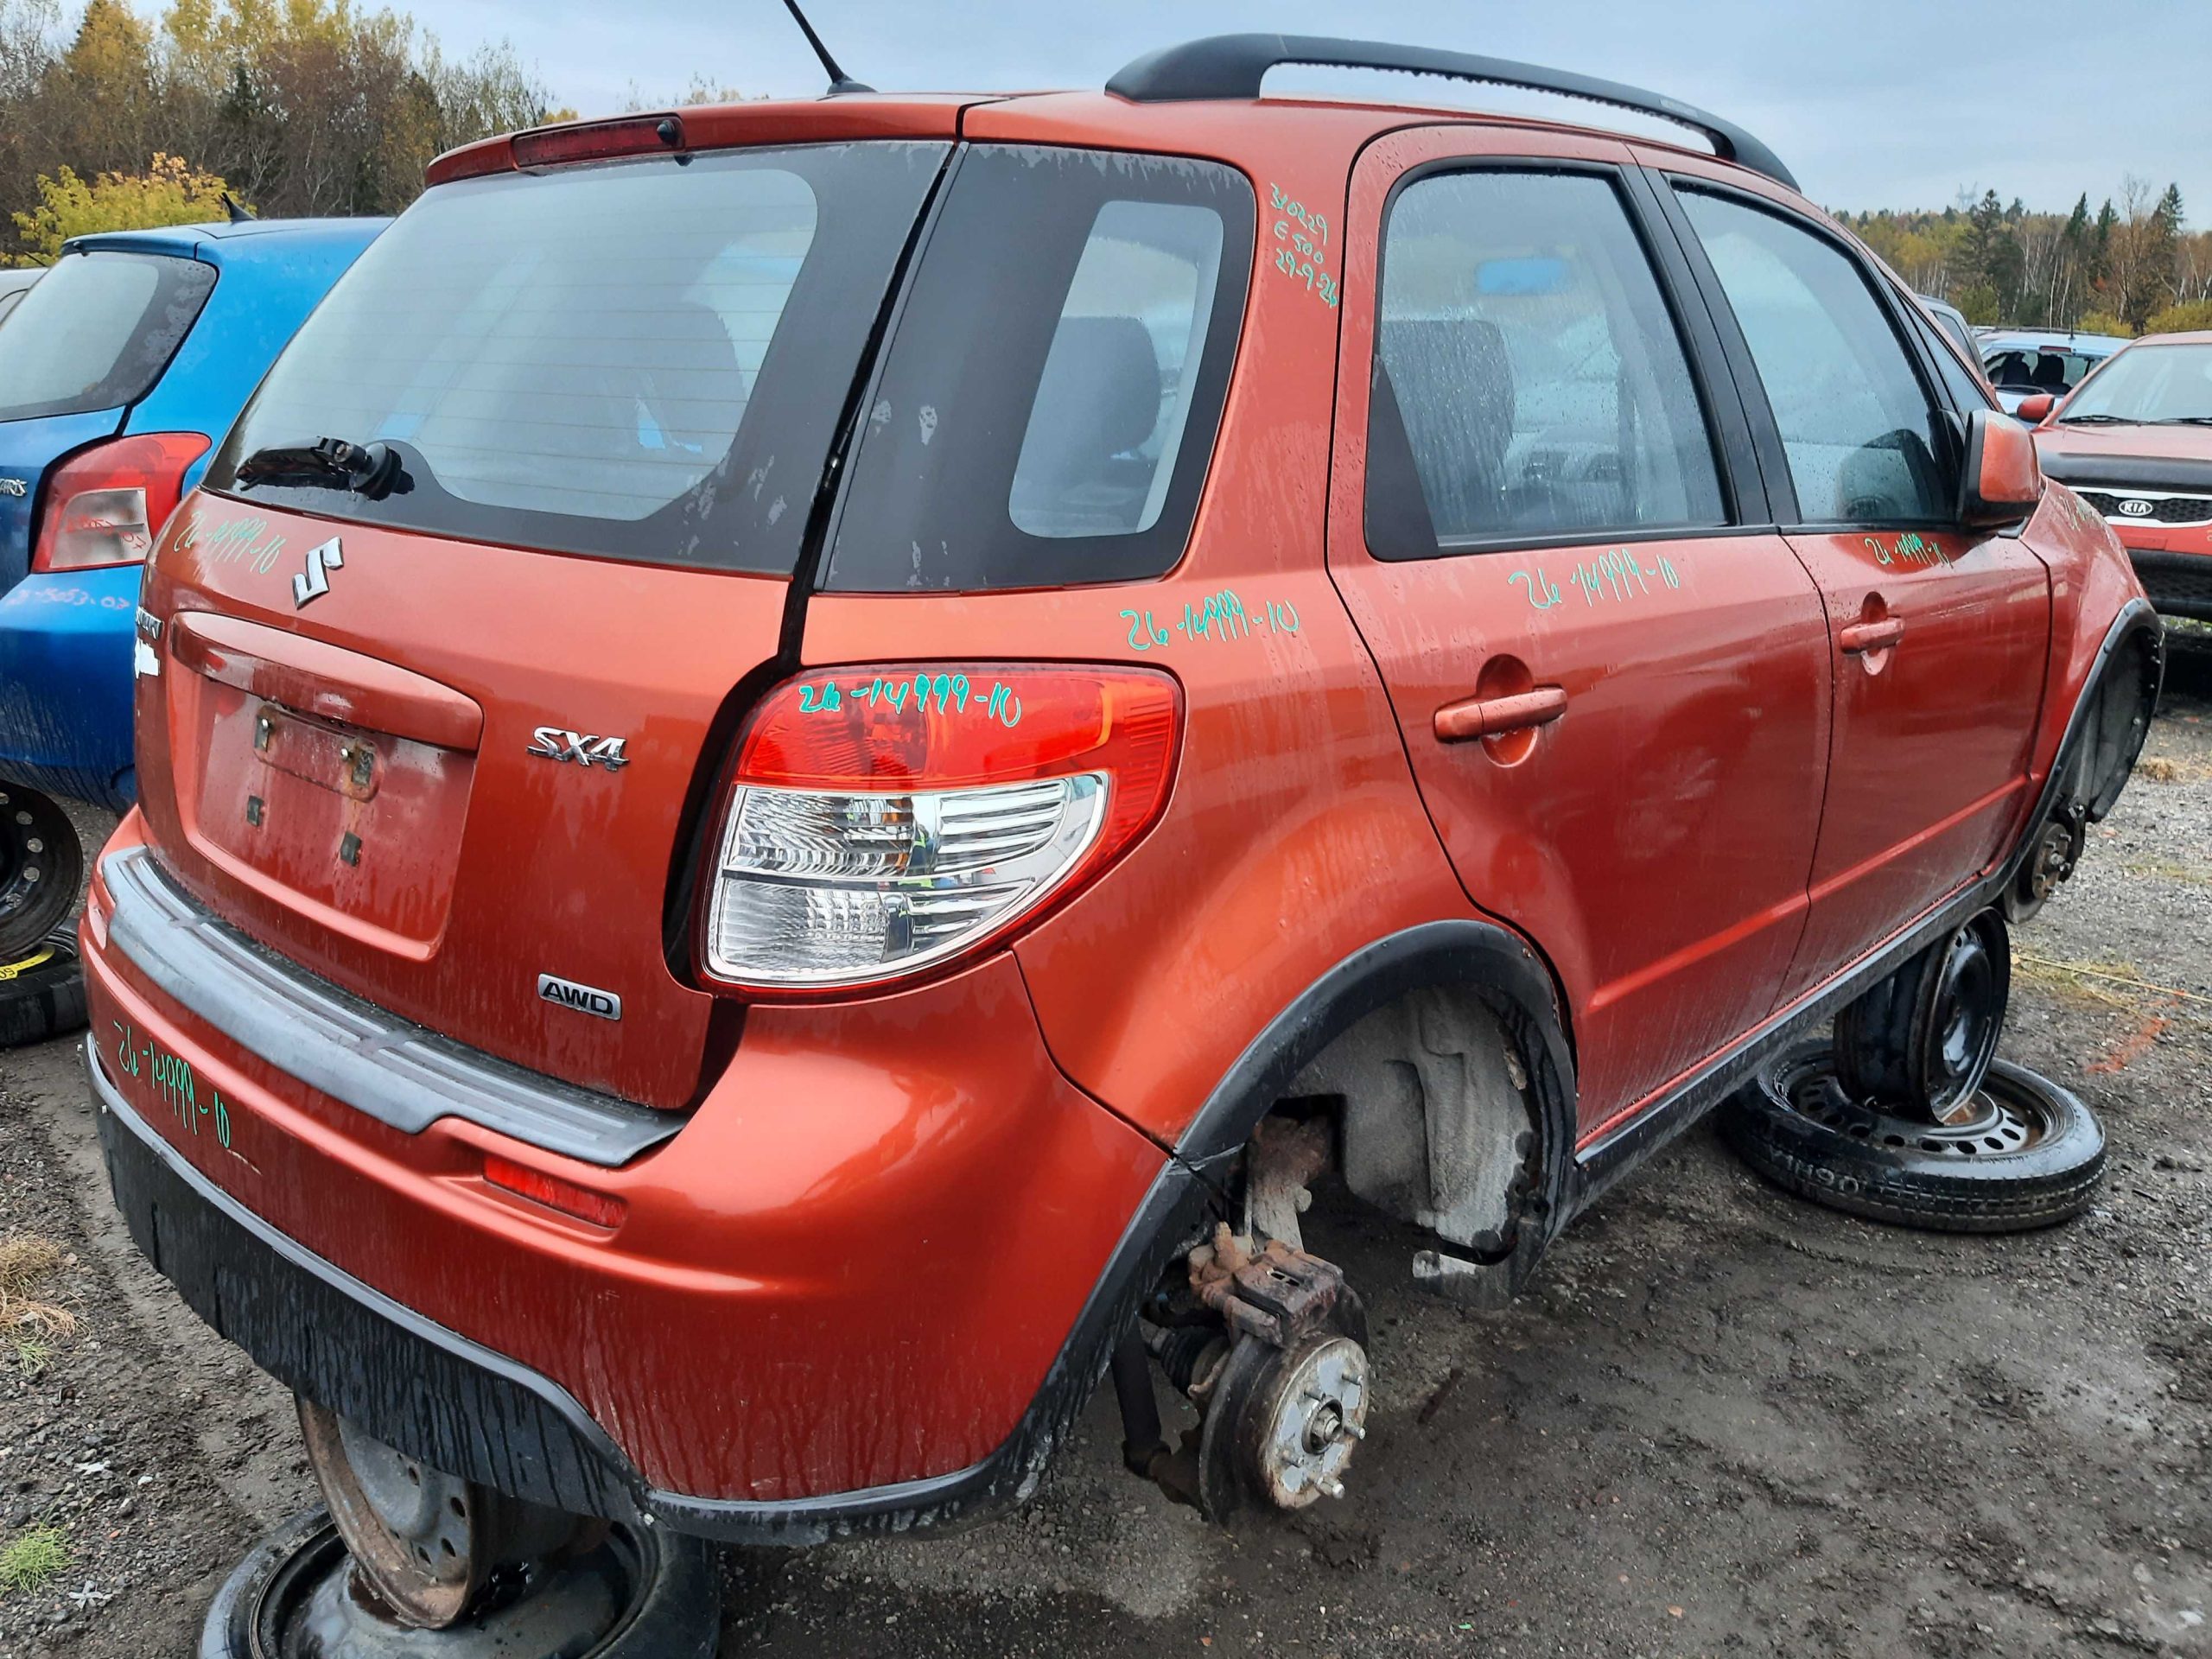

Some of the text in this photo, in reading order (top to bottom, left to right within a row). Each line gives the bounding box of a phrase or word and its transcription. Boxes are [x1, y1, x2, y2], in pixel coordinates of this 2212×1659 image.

[2123, 502, 2148, 514] KIA
[525, 726, 630, 772] SX4
[542, 981, 613, 1014] AWD
